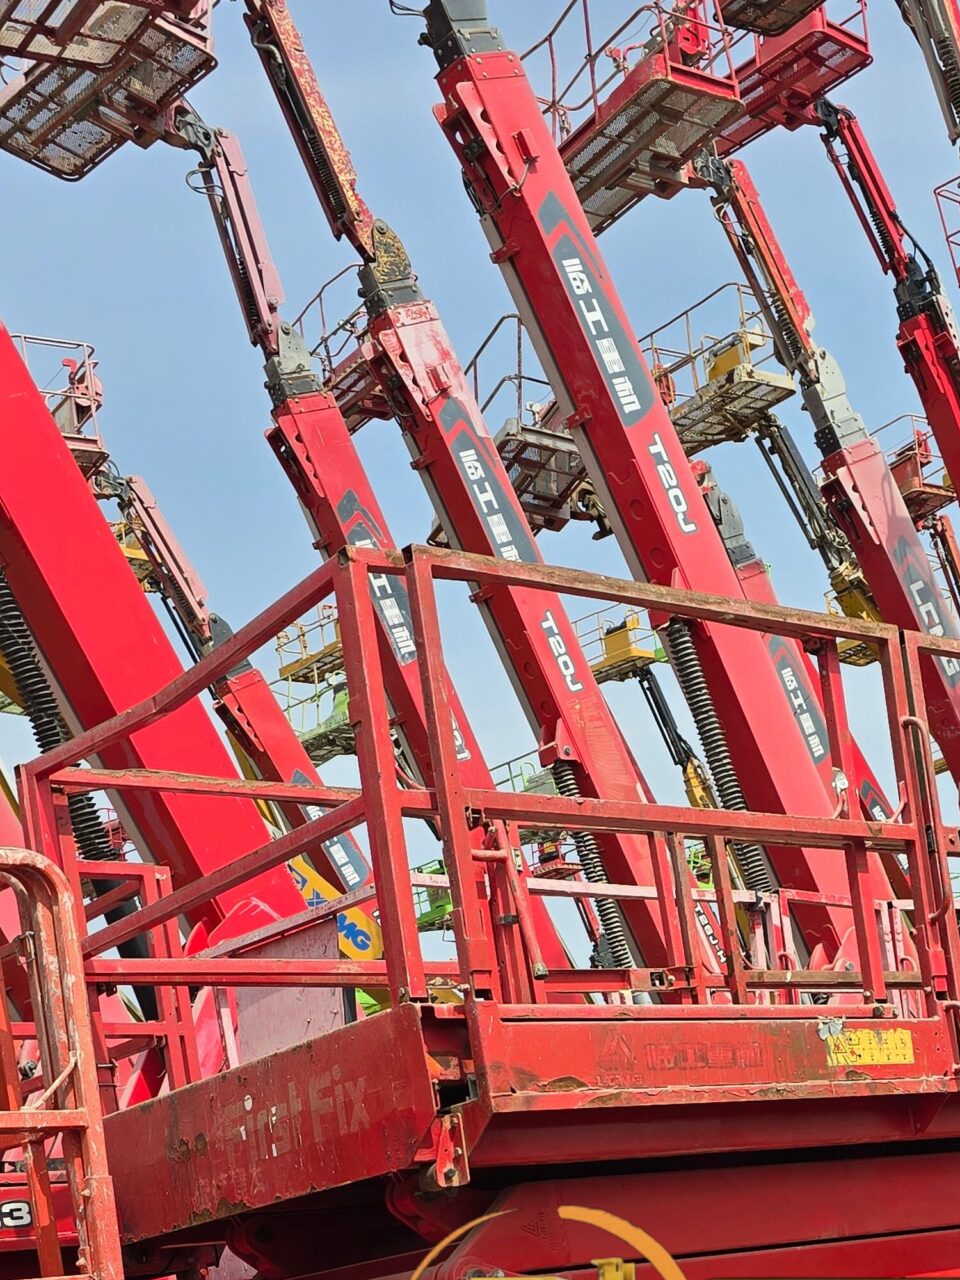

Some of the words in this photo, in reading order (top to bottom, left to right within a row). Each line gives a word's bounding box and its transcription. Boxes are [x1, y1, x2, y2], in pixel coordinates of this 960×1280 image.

[648, 433, 698, 534] T20J
[539, 611, 584, 692] T20J
[309, 1064, 370, 1142] Fix
